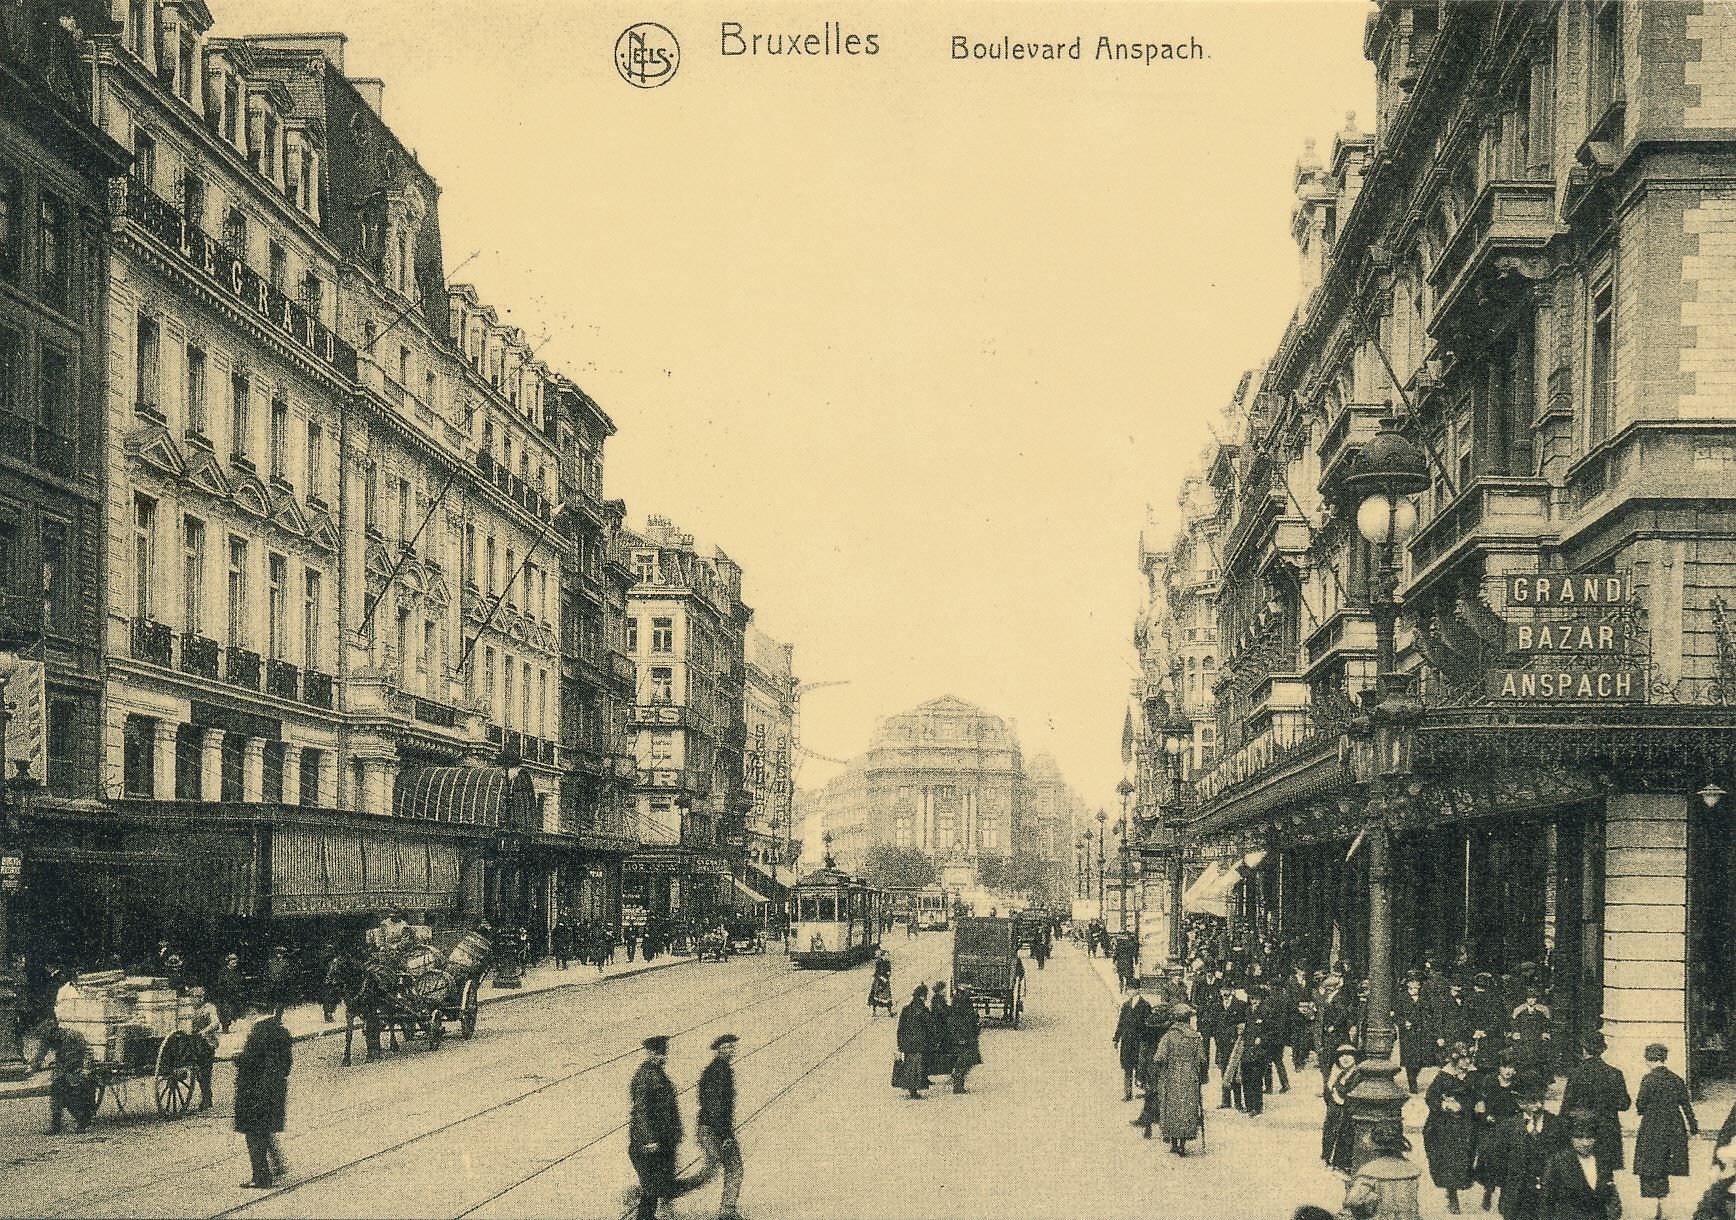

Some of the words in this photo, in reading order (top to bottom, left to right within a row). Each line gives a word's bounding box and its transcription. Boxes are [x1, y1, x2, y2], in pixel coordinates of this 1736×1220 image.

[231, 260, 334, 363] GRAND
[1514, 578, 1621, 602] GRAND
[1518, 626, 1614, 650] BAZAR
[1501, 673, 1631, 698] ANSPACH
